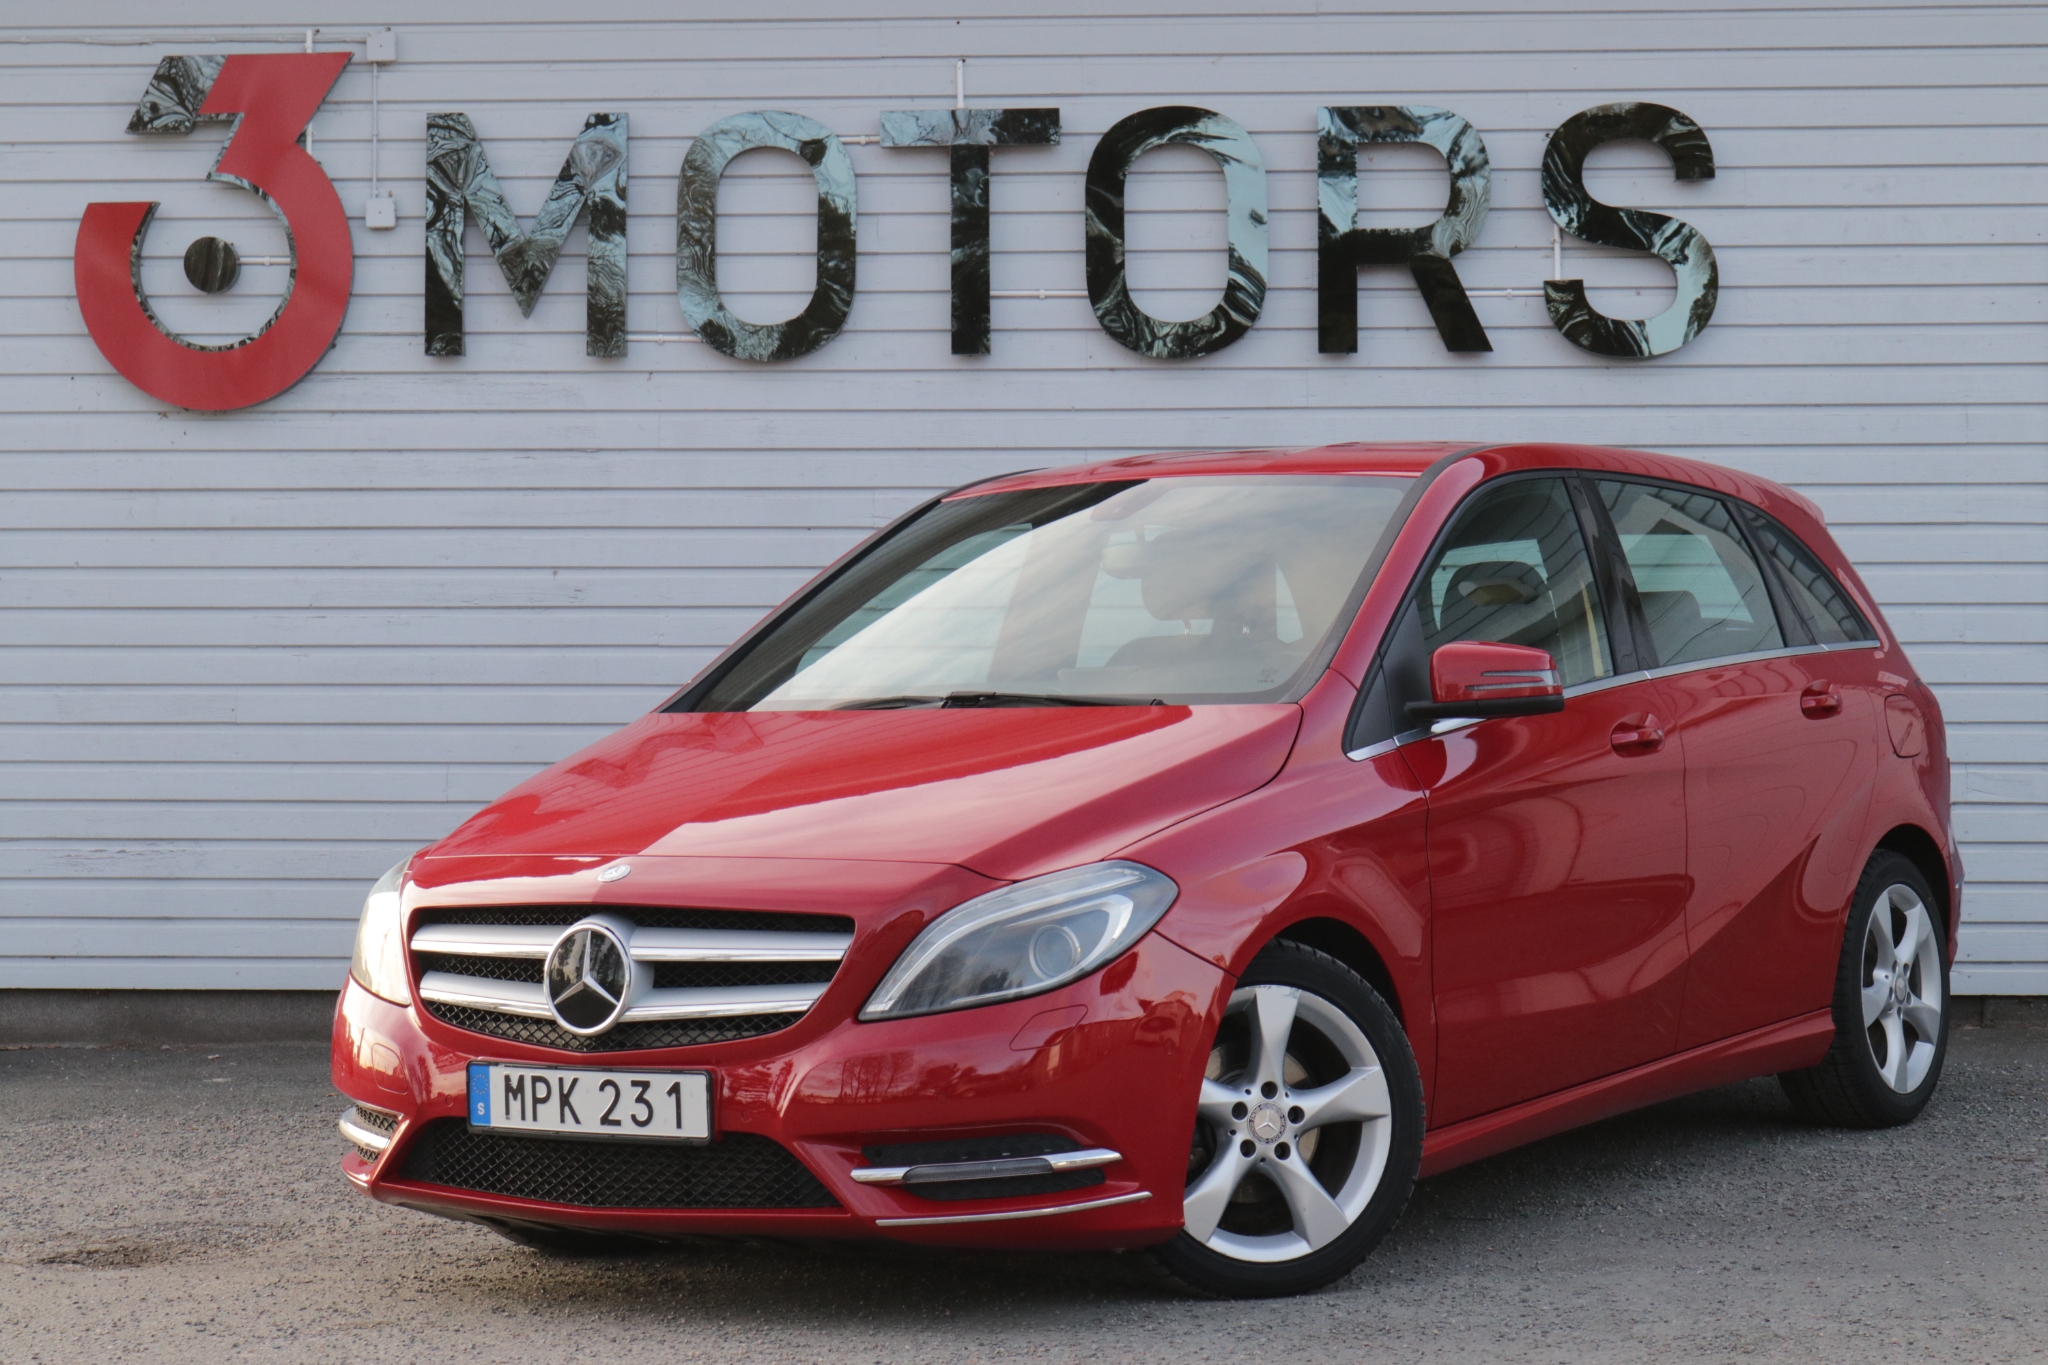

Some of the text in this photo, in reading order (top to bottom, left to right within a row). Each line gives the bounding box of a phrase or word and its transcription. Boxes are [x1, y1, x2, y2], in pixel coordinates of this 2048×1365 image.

[74, 52, 1719, 411] 3 MOTORS
[477, 1102, 485, 1116] S
[503, 1074, 682, 1129] MPK 231
